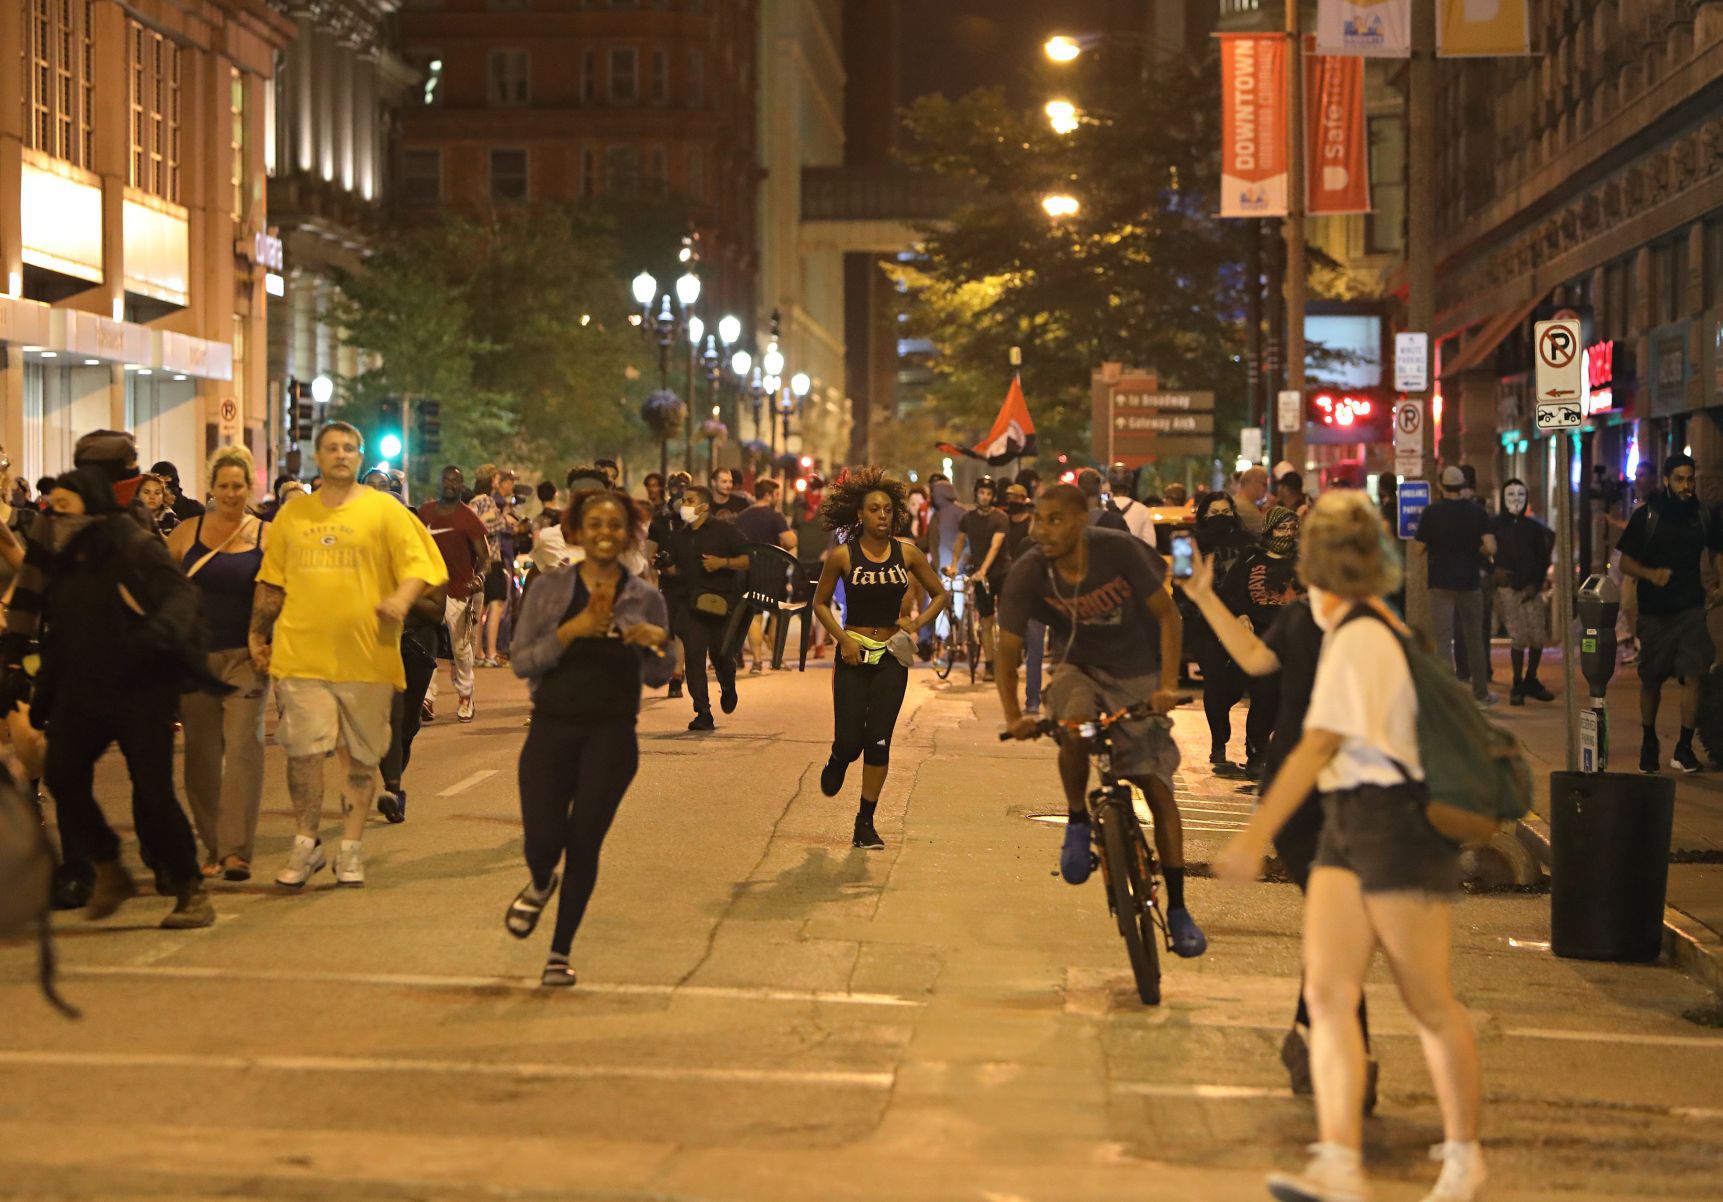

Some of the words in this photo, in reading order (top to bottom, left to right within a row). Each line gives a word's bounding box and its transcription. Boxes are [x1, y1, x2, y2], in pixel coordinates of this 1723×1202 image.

[1234, 39, 1255, 170] DOWNTOWN
[296, 548, 361, 569] ACKERS
[851, 563, 909, 588] faith
